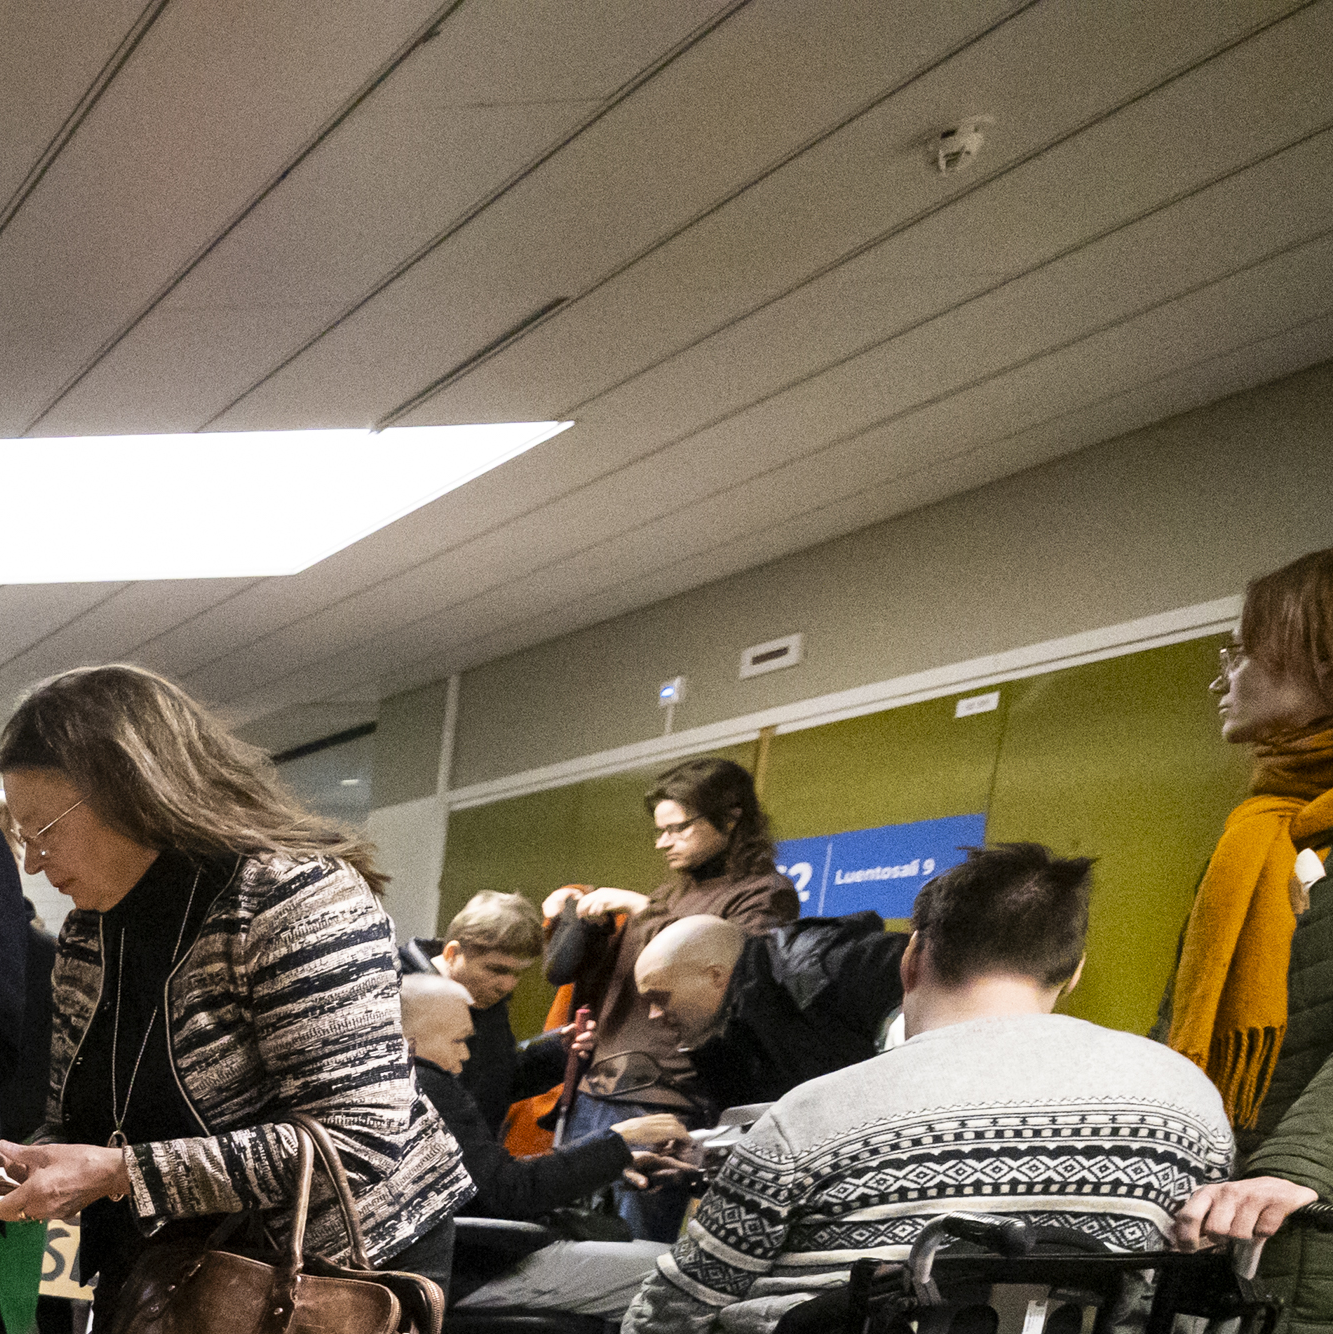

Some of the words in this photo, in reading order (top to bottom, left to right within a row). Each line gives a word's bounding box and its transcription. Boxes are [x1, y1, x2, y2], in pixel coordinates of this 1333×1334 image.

[776, 862, 813, 903] 2
[834, 858, 921, 886] Luentosali
[922, 858, 936, 876] 9
